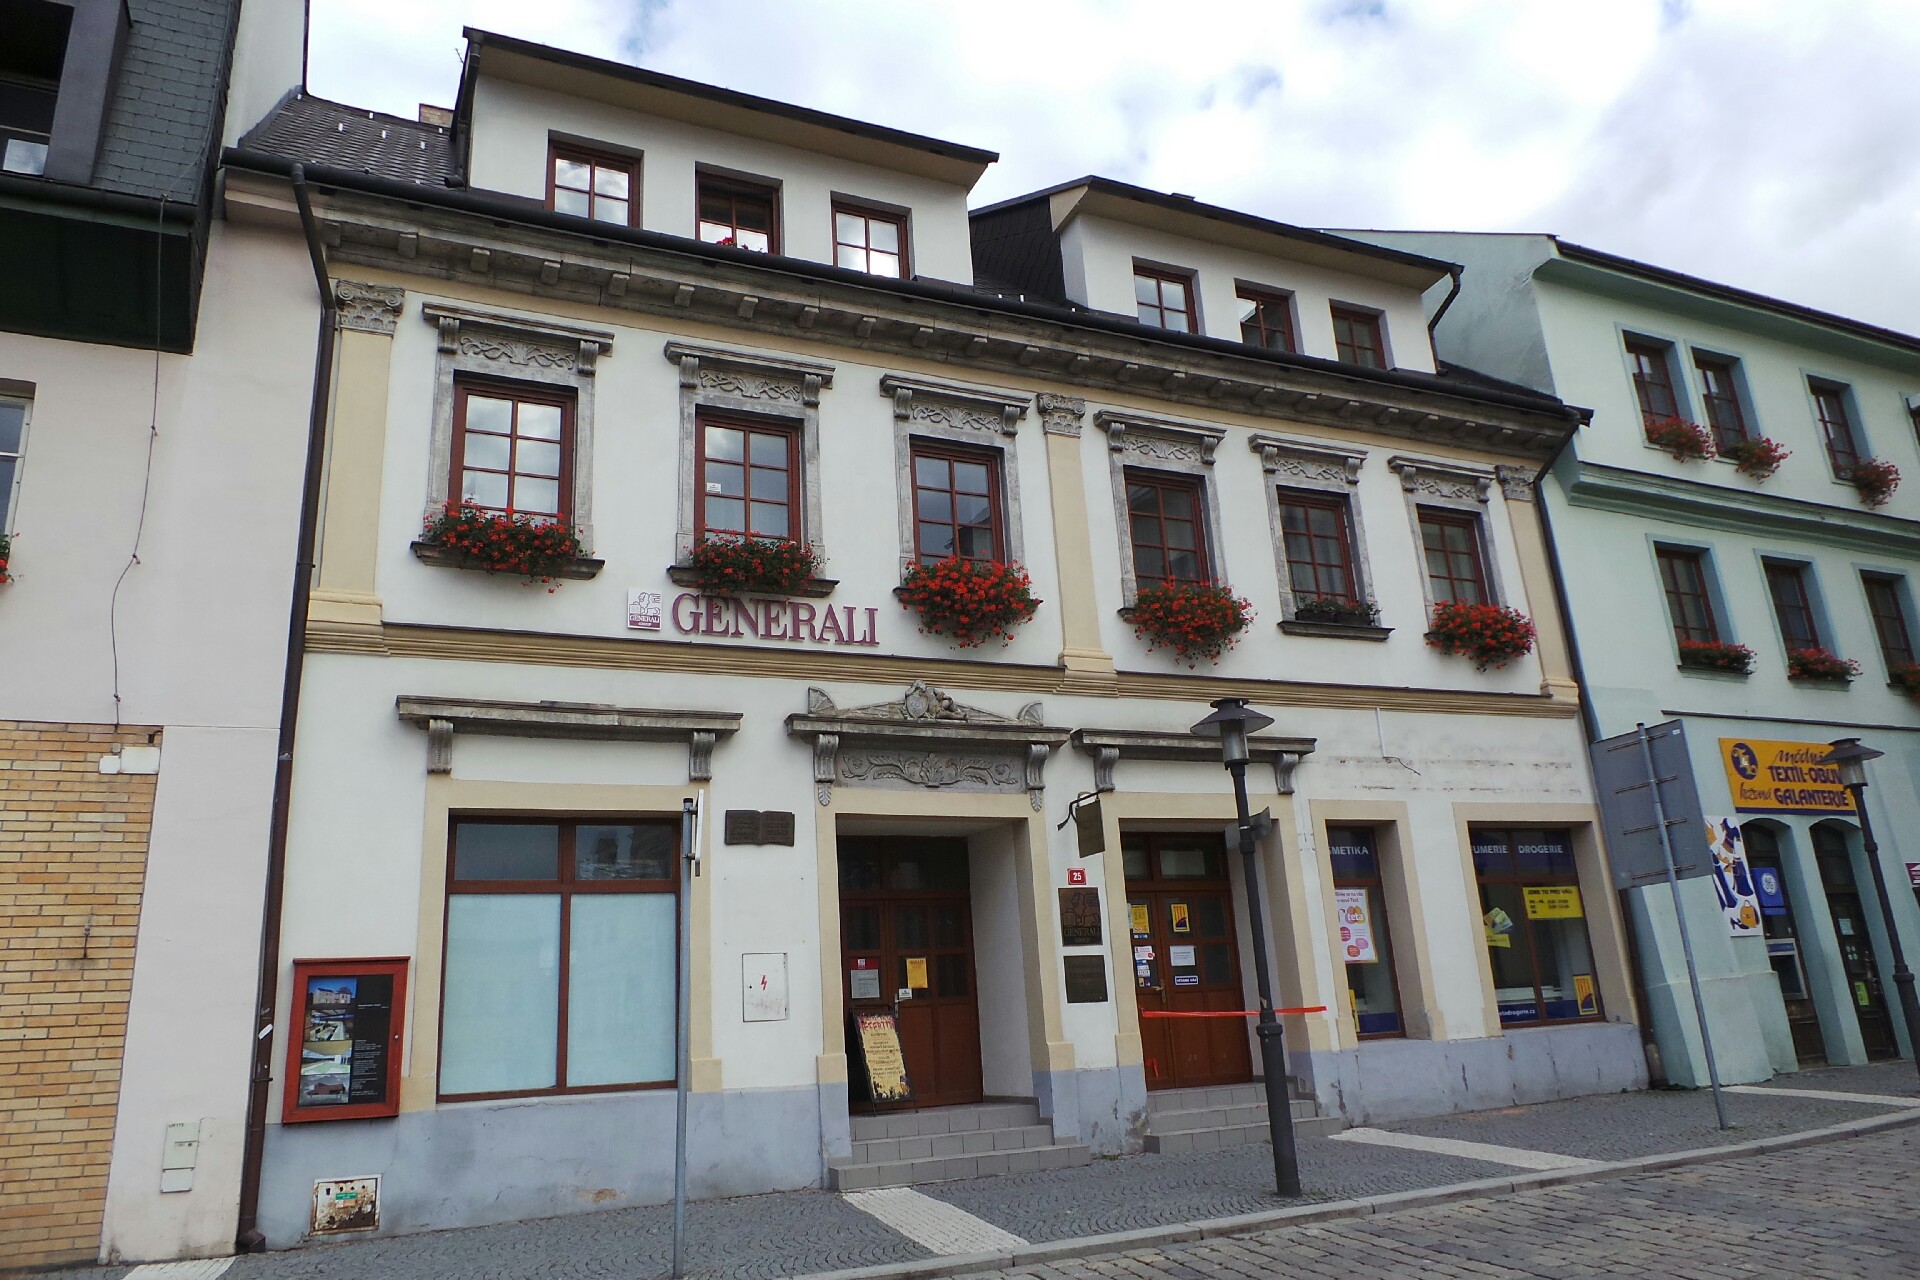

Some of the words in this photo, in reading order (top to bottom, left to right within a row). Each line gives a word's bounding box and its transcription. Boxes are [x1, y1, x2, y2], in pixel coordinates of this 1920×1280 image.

[629, 614, 660, 624] GENERALI
[671, 592, 880, 646] GENERALI
[1773, 787, 1849, 807] GALANTERIE
[1518, 844, 1563, 854] DROGERIE
[1072, 872, 1082, 881] 25
[1347, 912, 1364, 921] teta
[1064, 928, 1100, 937] GENERALI
